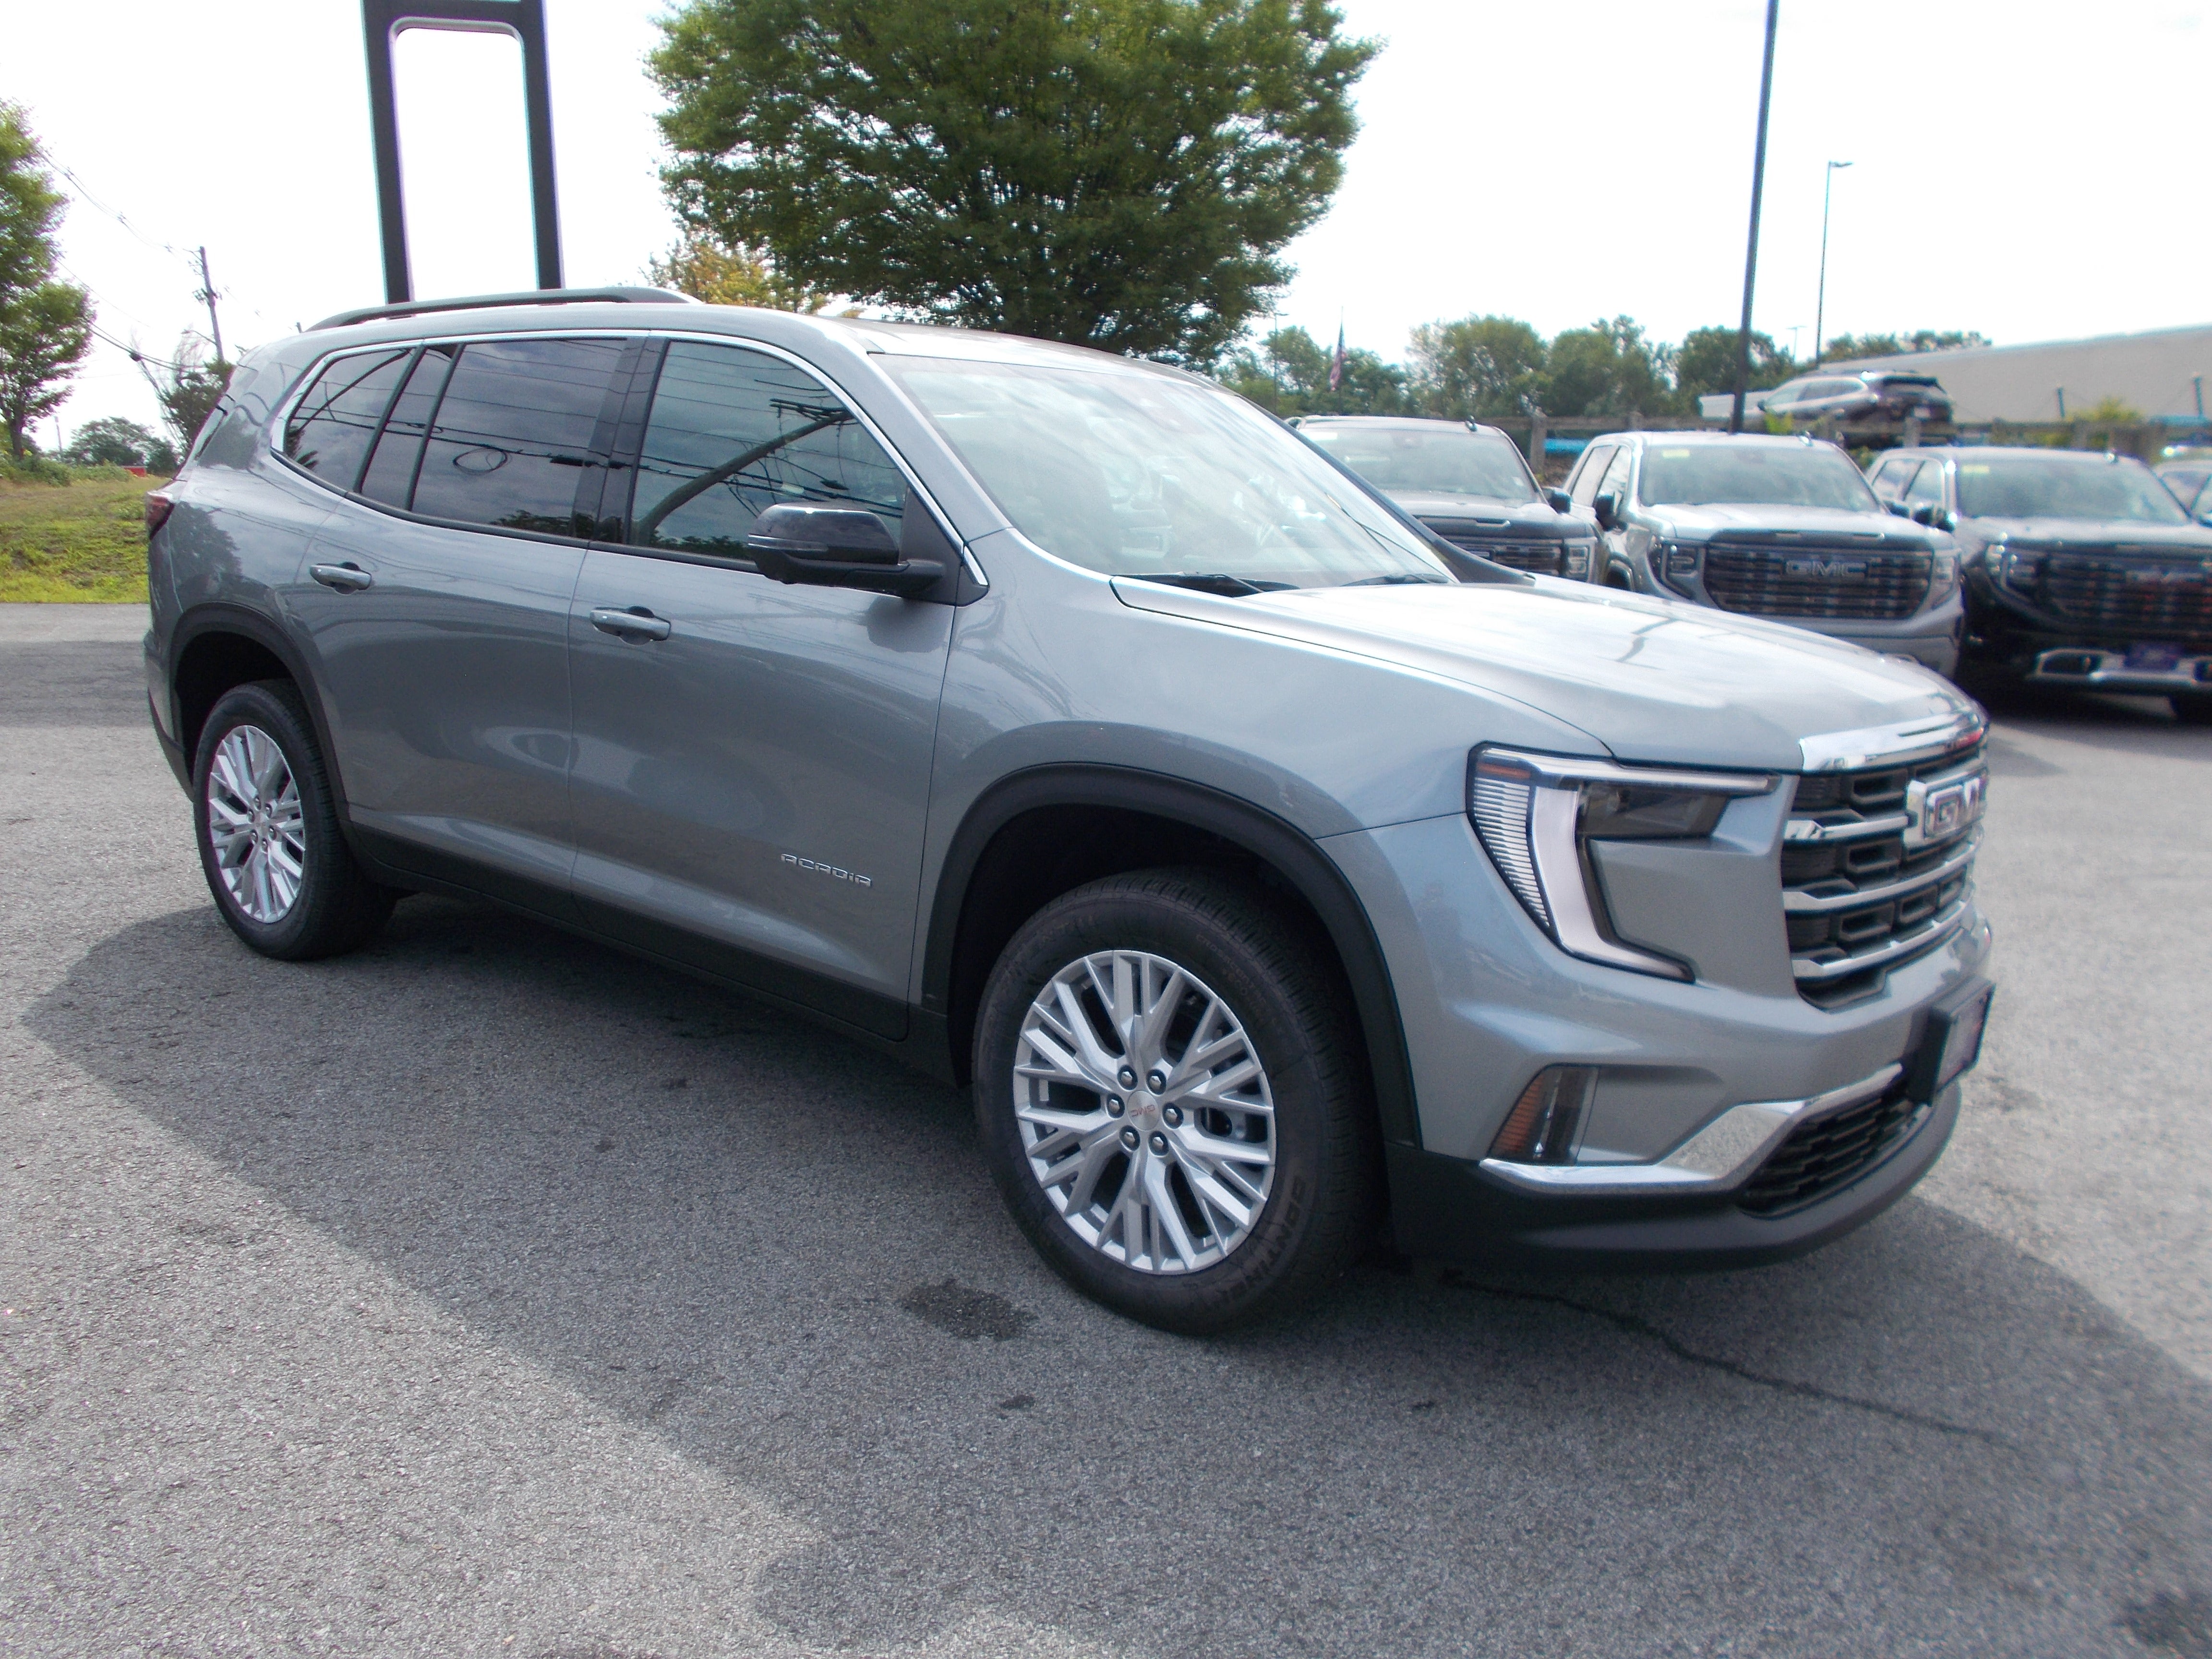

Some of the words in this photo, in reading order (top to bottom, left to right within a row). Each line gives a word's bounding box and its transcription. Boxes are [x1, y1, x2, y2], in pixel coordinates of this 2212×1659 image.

[1926, 778, 1987, 833] GM
[781, 854, 872, 887] ACADIA
[1130, 1105, 1155, 1117] GMC
